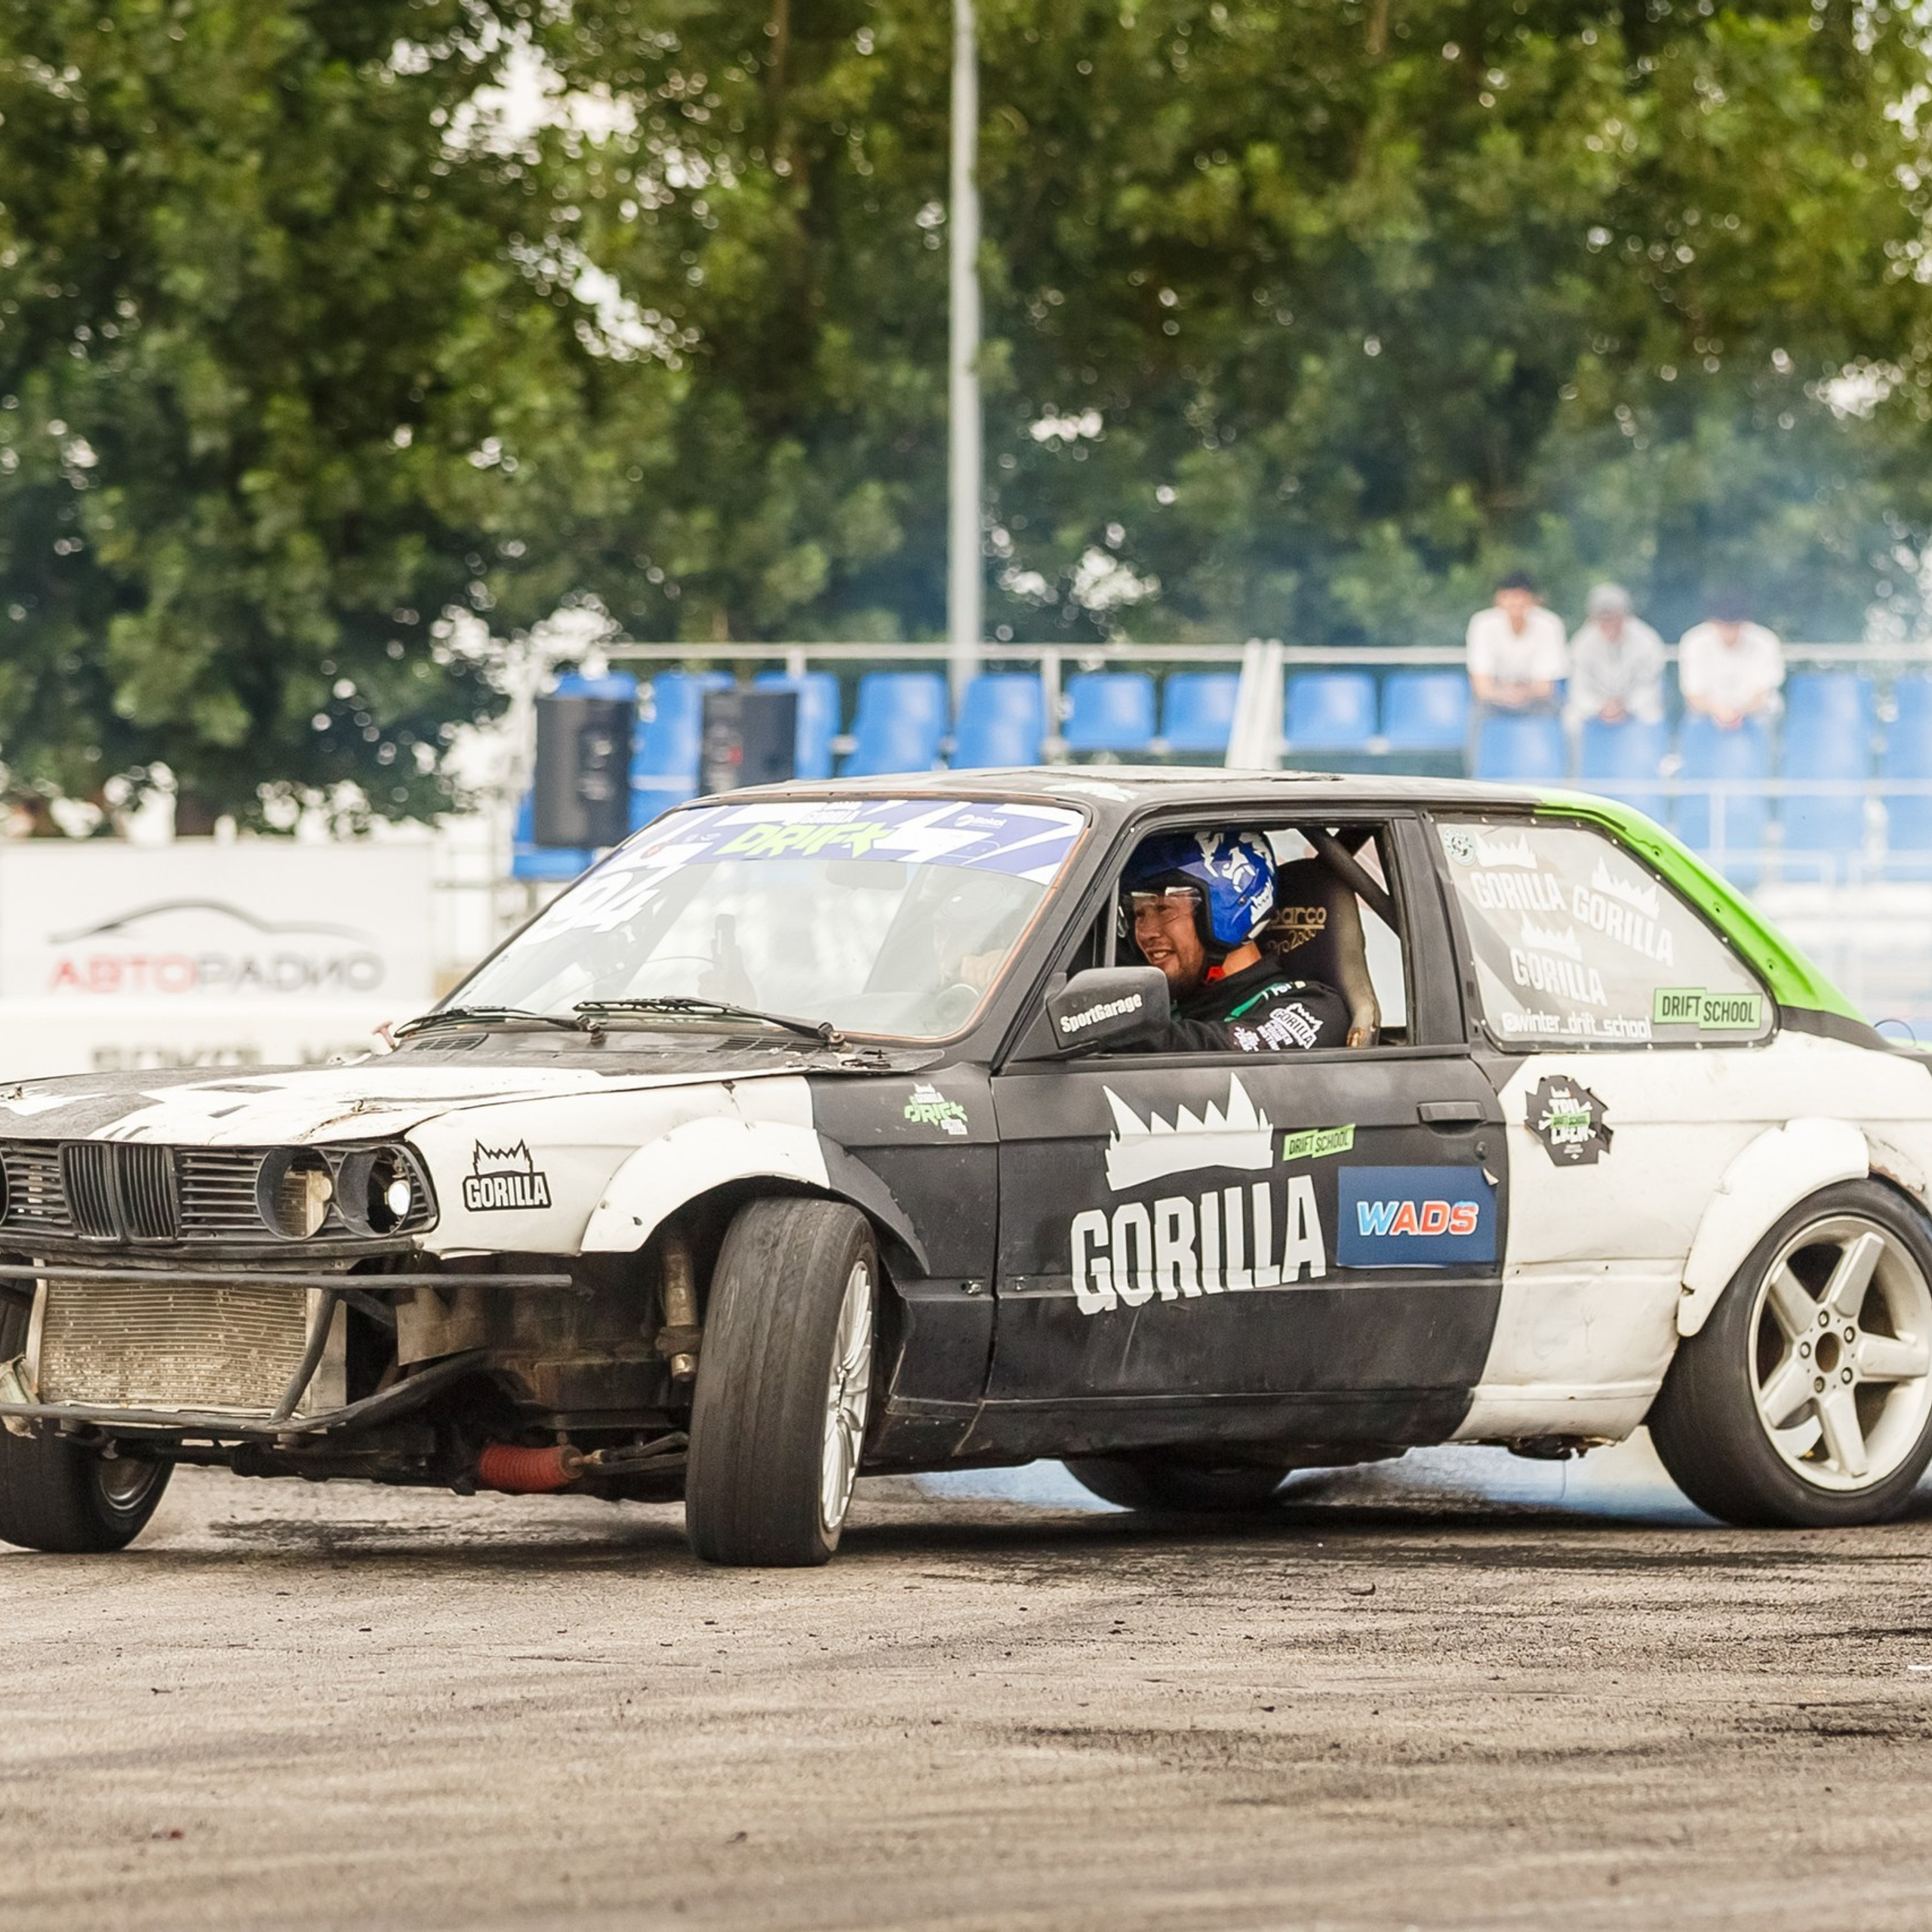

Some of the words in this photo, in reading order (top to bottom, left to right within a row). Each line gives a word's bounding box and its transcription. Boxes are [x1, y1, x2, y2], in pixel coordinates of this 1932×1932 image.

[1471, 872, 1567, 910] GORILLA
[1572, 884, 1674, 968] GORILLA
[1509, 947, 1608, 1007] GORILLA
[1060, 993, 1143, 1032] SportGarage
[1272, 1010, 1314, 1044] GORILLA
[1662, 995, 1702, 1017] DRIFT
[1703, 1001, 1755, 1023] SCHOOL
[1289, 1134, 1314, 1155] DRIFT
[1315, 1131, 1348, 1152] SCHOOL
[465, 1175, 549, 1208] GORILLA
[1357, 1200, 1478, 1235] WADS
[1070, 1174, 1327, 1315] GORILLA
